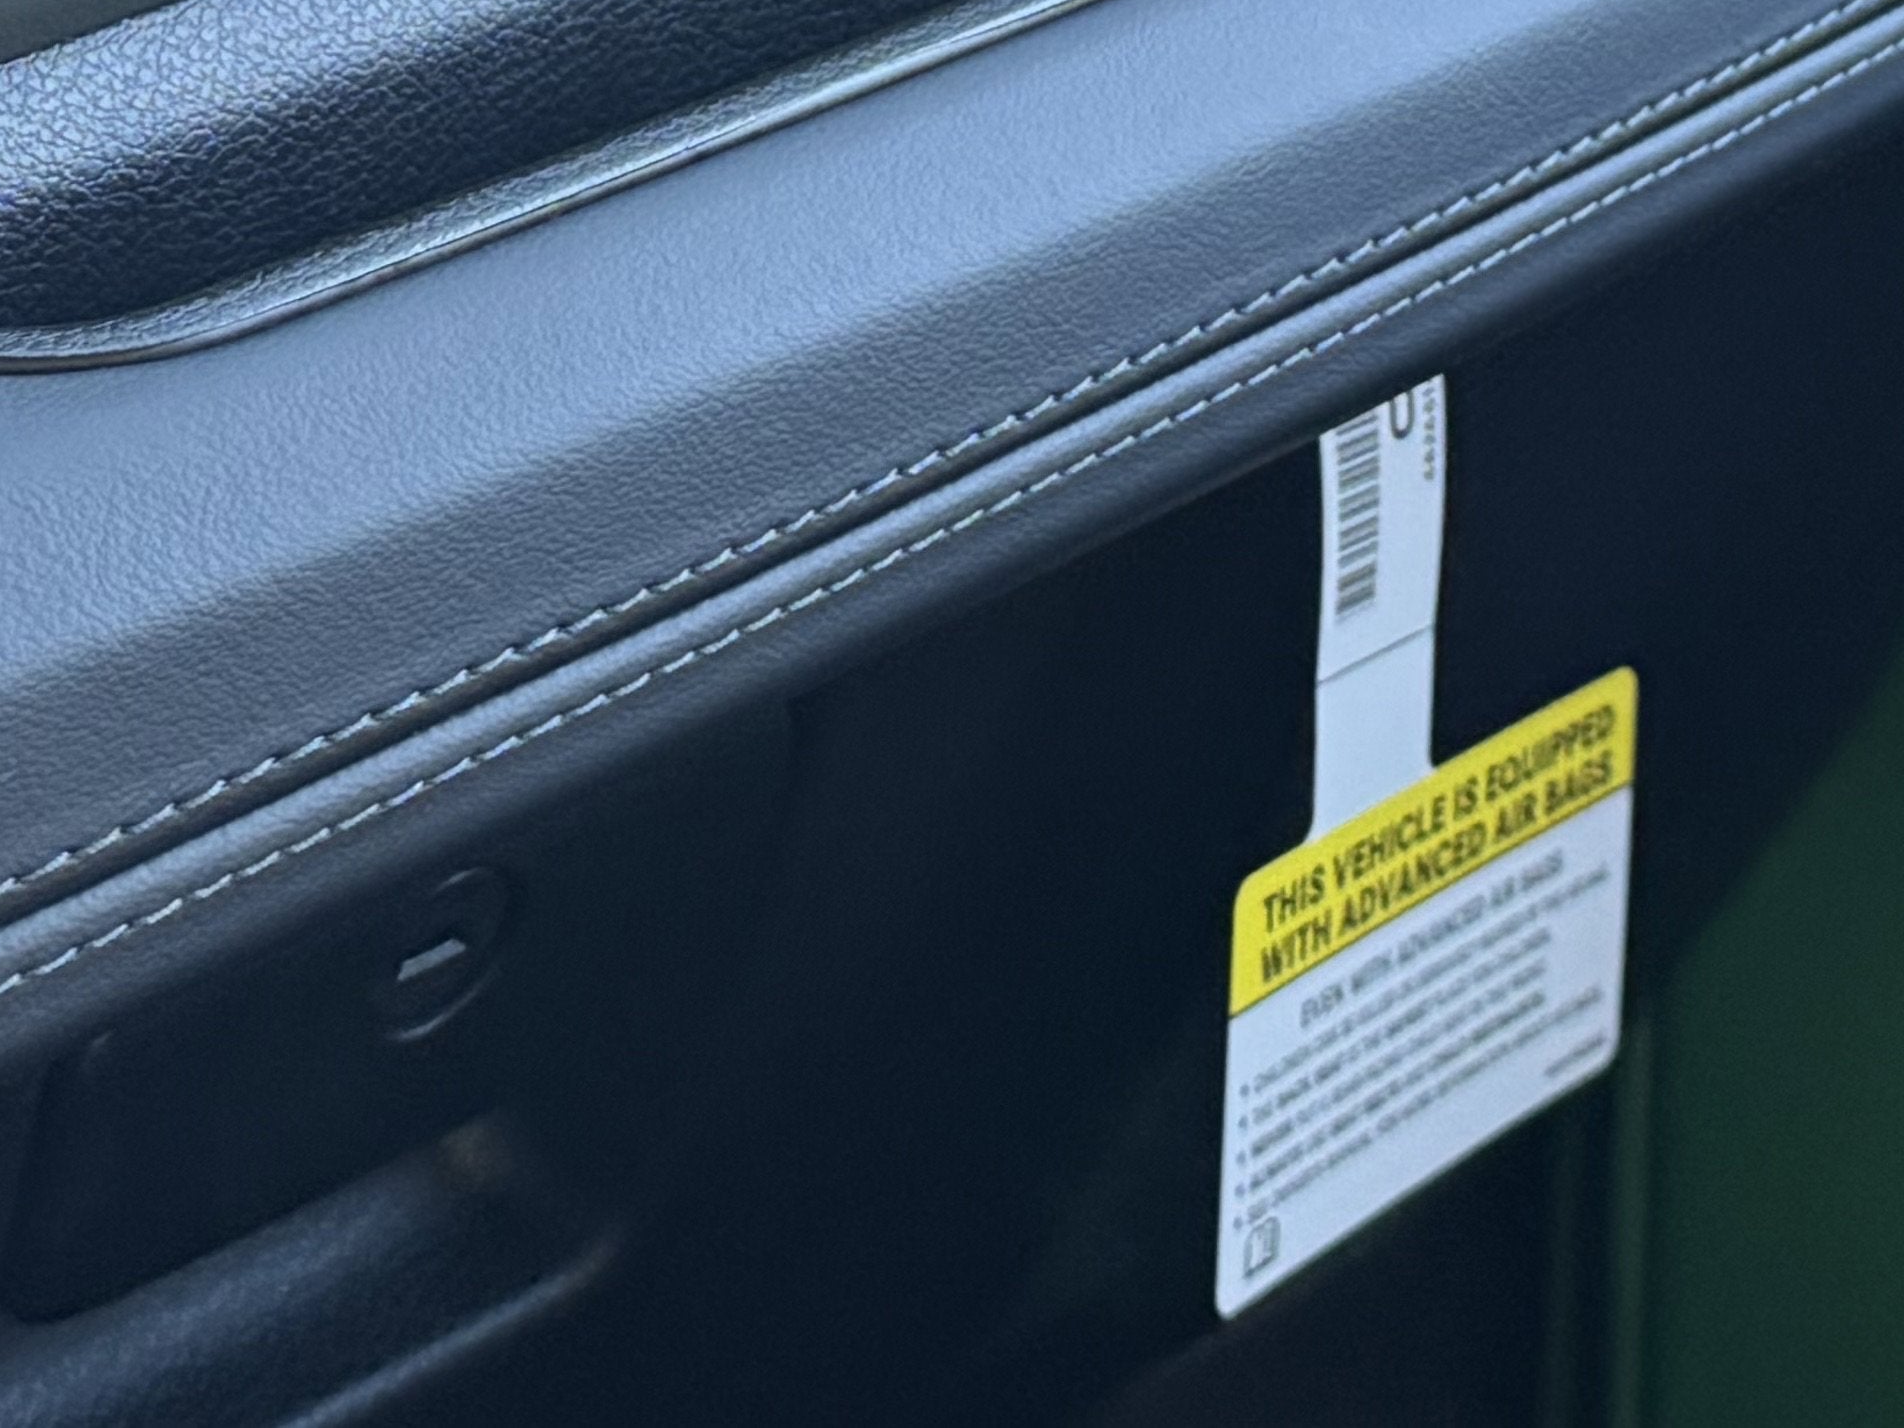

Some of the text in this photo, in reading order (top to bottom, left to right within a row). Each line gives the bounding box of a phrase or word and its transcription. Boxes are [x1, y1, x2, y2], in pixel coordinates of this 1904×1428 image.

[1260, 749, 1614, 984] WITH ADVANCED AIR BAGS
[1262, 704, 1616, 934] THIS VEHICLE IS EQUIPPED
